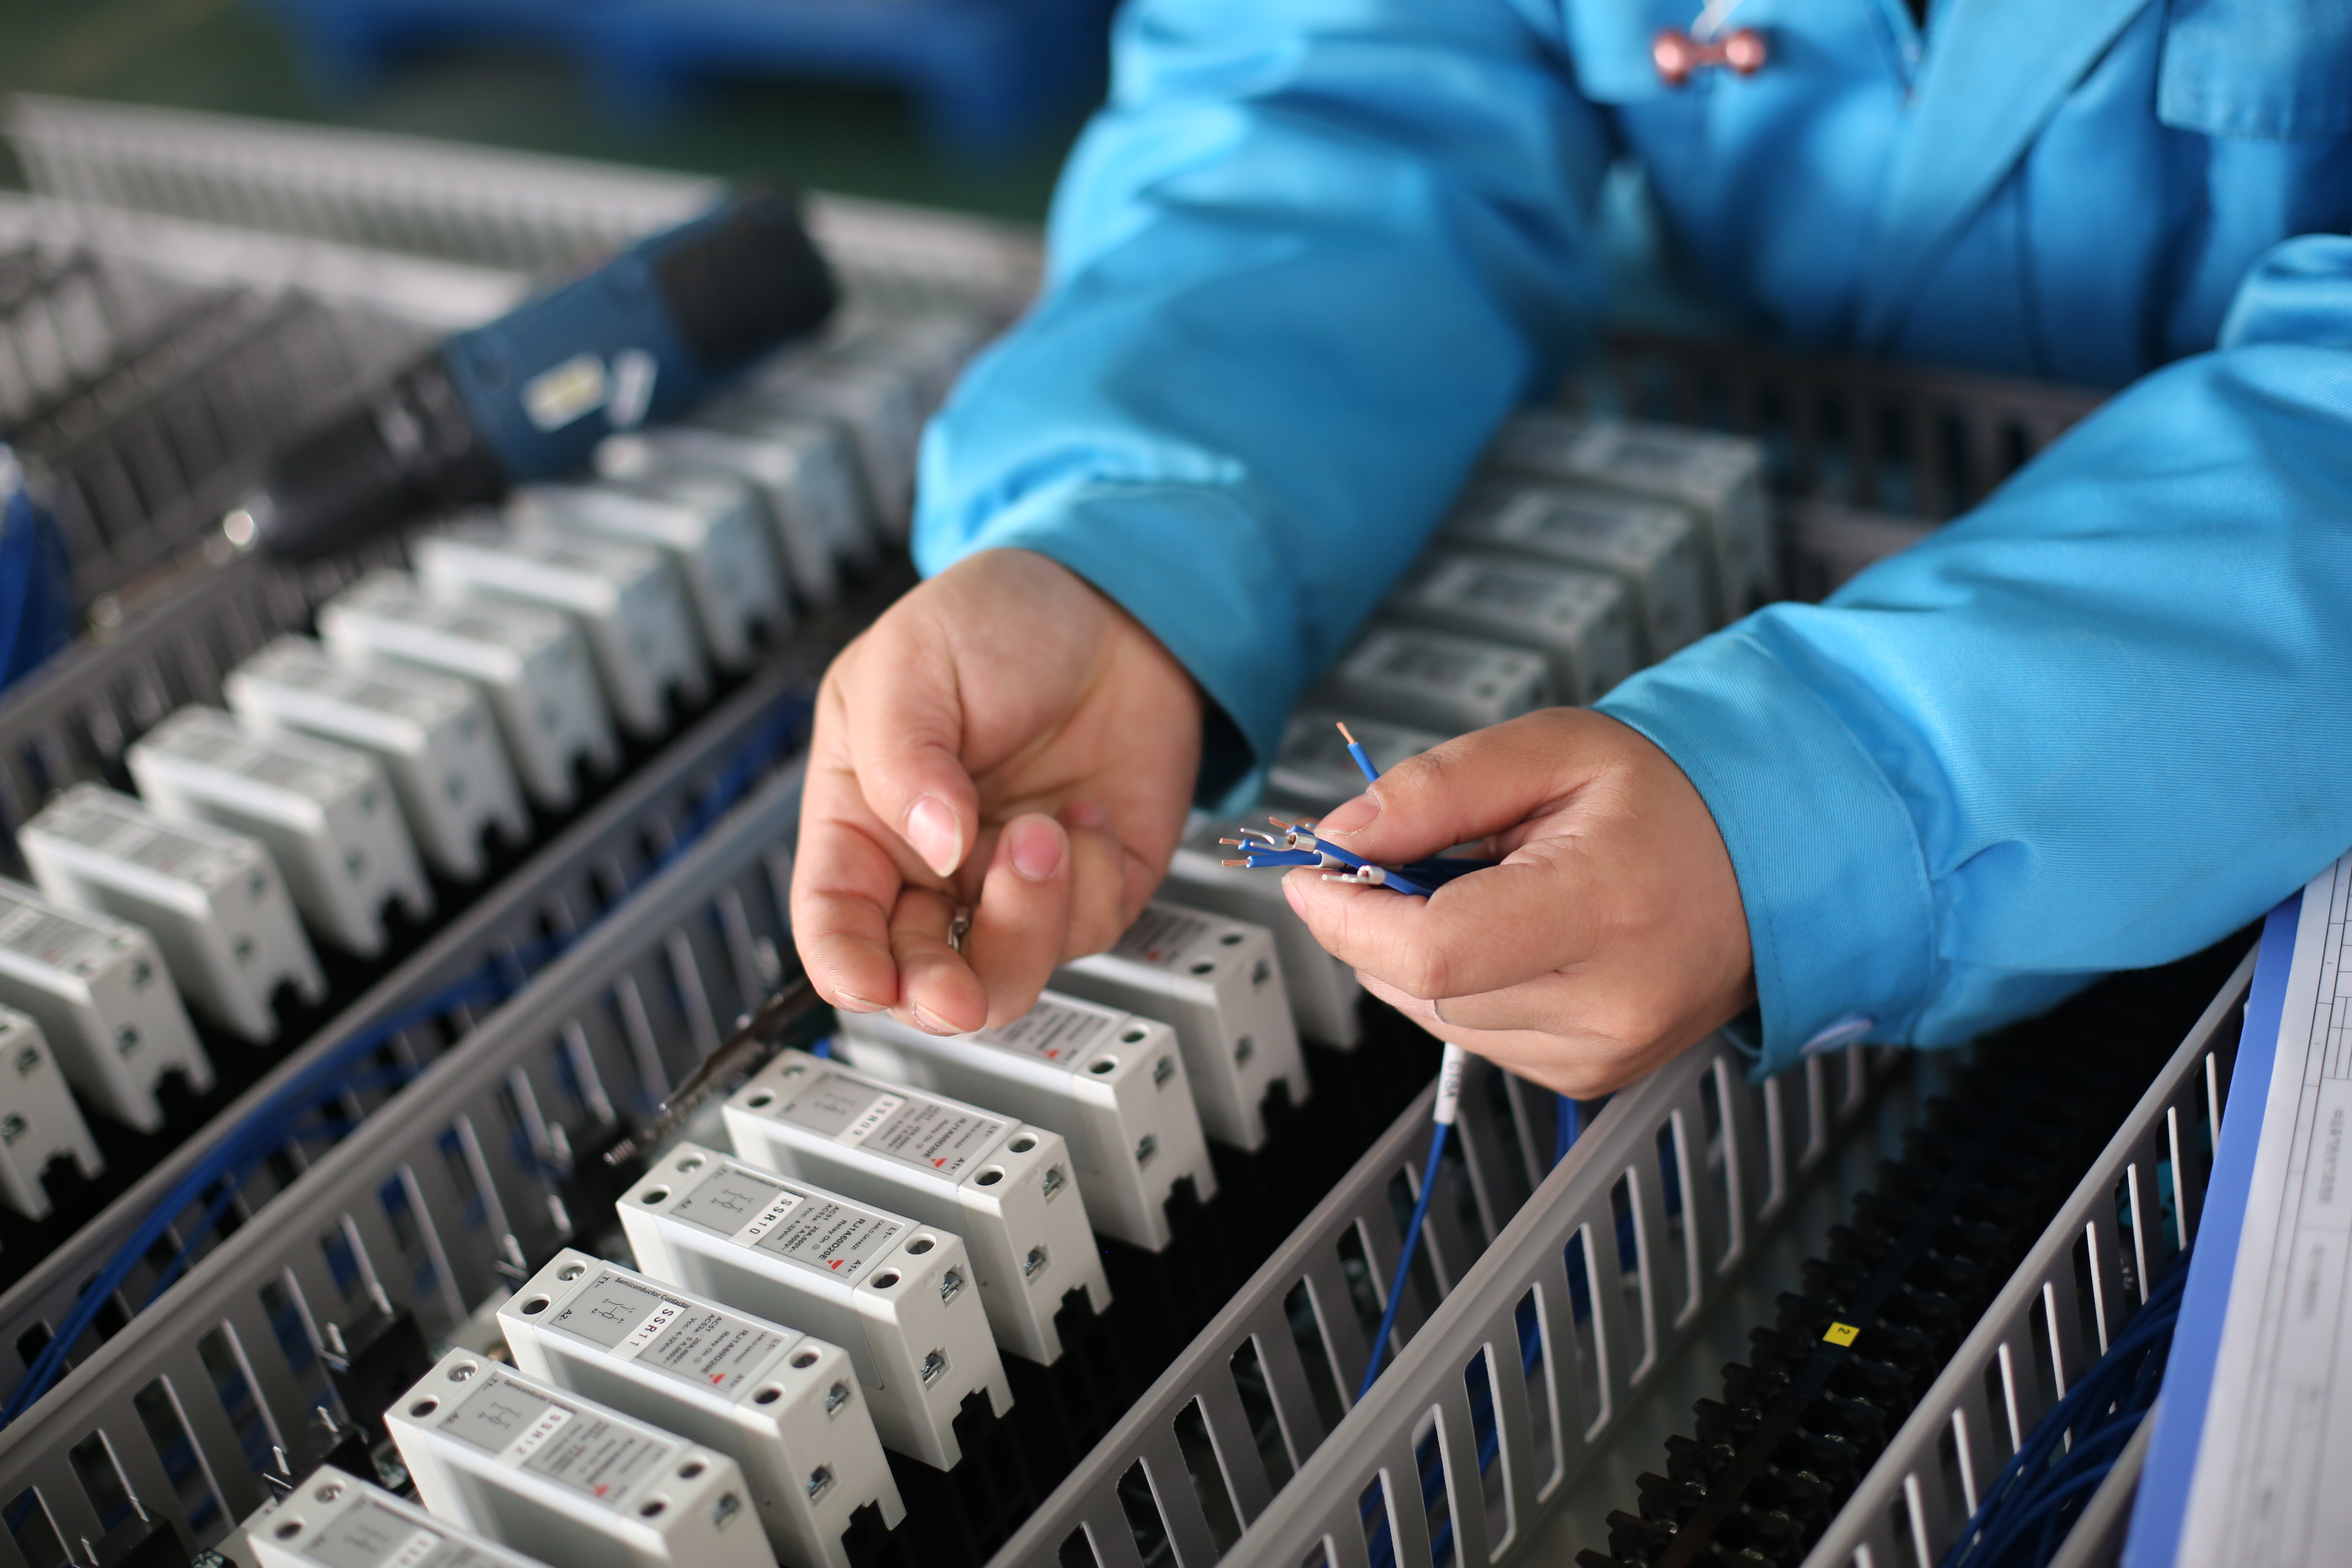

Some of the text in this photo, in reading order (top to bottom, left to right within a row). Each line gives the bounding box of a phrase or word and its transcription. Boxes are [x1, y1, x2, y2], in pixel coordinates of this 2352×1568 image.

[853, 1102, 893, 1136] SSR09
[749, 1199, 792, 1234] SSR10
[800, 1207, 815, 1218] Vcc:
[823, 1206, 839, 1220] AC51
[829, 1220, 847, 1234] Relay
[818, 1218, 865, 1260] RJ1A60D20E
[851, 1220, 884, 1250] CARLO GAVAZZI
[848, 1260, 861, 1272] A1+
[615, 1277, 691, 1310] Semiconductor Contactor
[630, 1309, 674, 1346] SSR11
[682, 1318, 697, 1330] Vcc:
[706, 1316, 722, 1331] AC51
[702, 1330, 748, 1373] RJ1A60D20E
[711, 1331, 730, 1347] Relay
[734, 1332, 766, 1363] CARLO GAVAZZI
